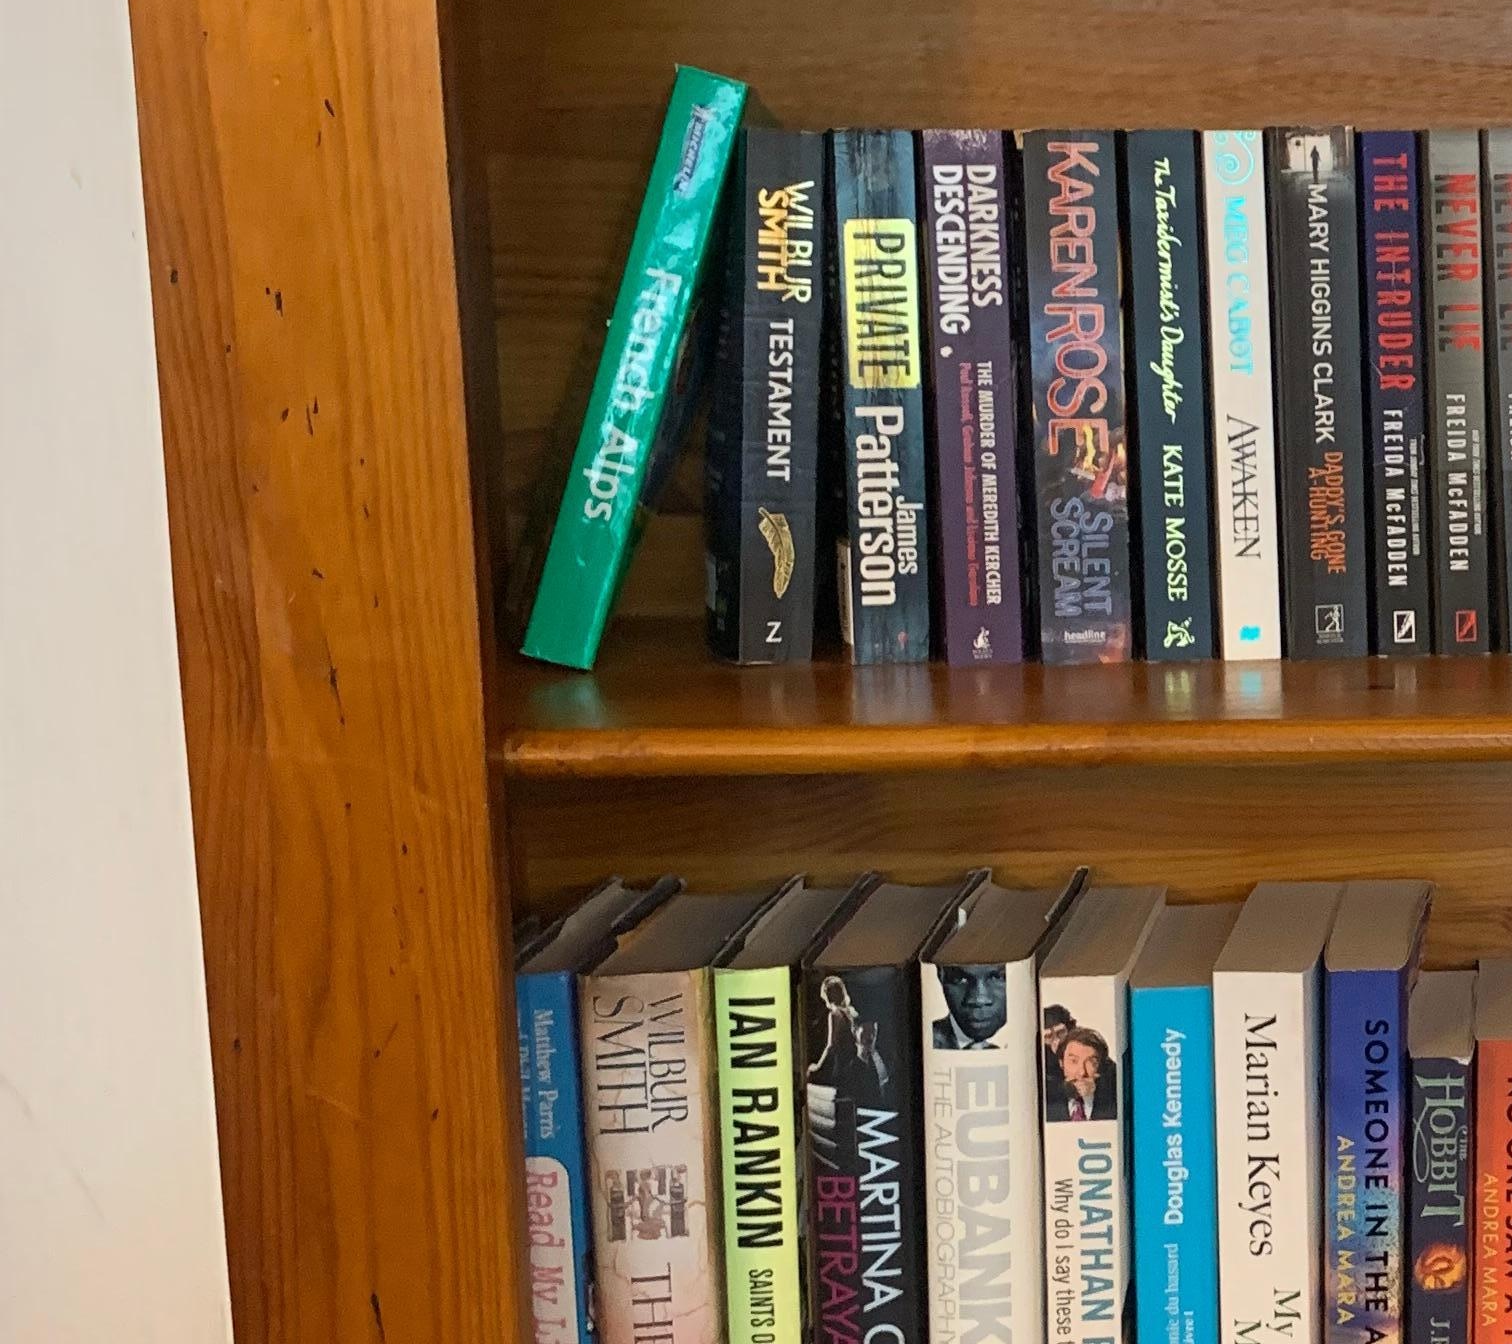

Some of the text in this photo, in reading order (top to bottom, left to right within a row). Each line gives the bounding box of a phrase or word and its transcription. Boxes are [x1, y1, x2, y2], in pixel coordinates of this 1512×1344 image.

[854, 232, 911, 378] PRIVATE
[1045, 141, 1108, 456] KAREN ROSE
[1307, 184, 1335, 444] MARY HIGGINS CLARK
[583, 267, 683, 520] French Alps
[766, 319, 793, 482] TESTAMENT
[855, 405, 903, 606] Patterson
[896, 496, 924, 575] James
[1161, 445, 1188, 601] KATE MOSSE
[727, 997, 783, 1248] IAN RANKIN
[1051, 1177, 1073, 1217] Why
[855, 1107, 902, 1311] MARTINA
[1052, 1255, 1073, 1284] say
[1054, 1220, 1075, 1239] do
[1076, 1138, 1113, 1323] JONATHAN
[748, 1268, 774, 1327] SAINTS
[1057, 1288, 1075, 1334] these
